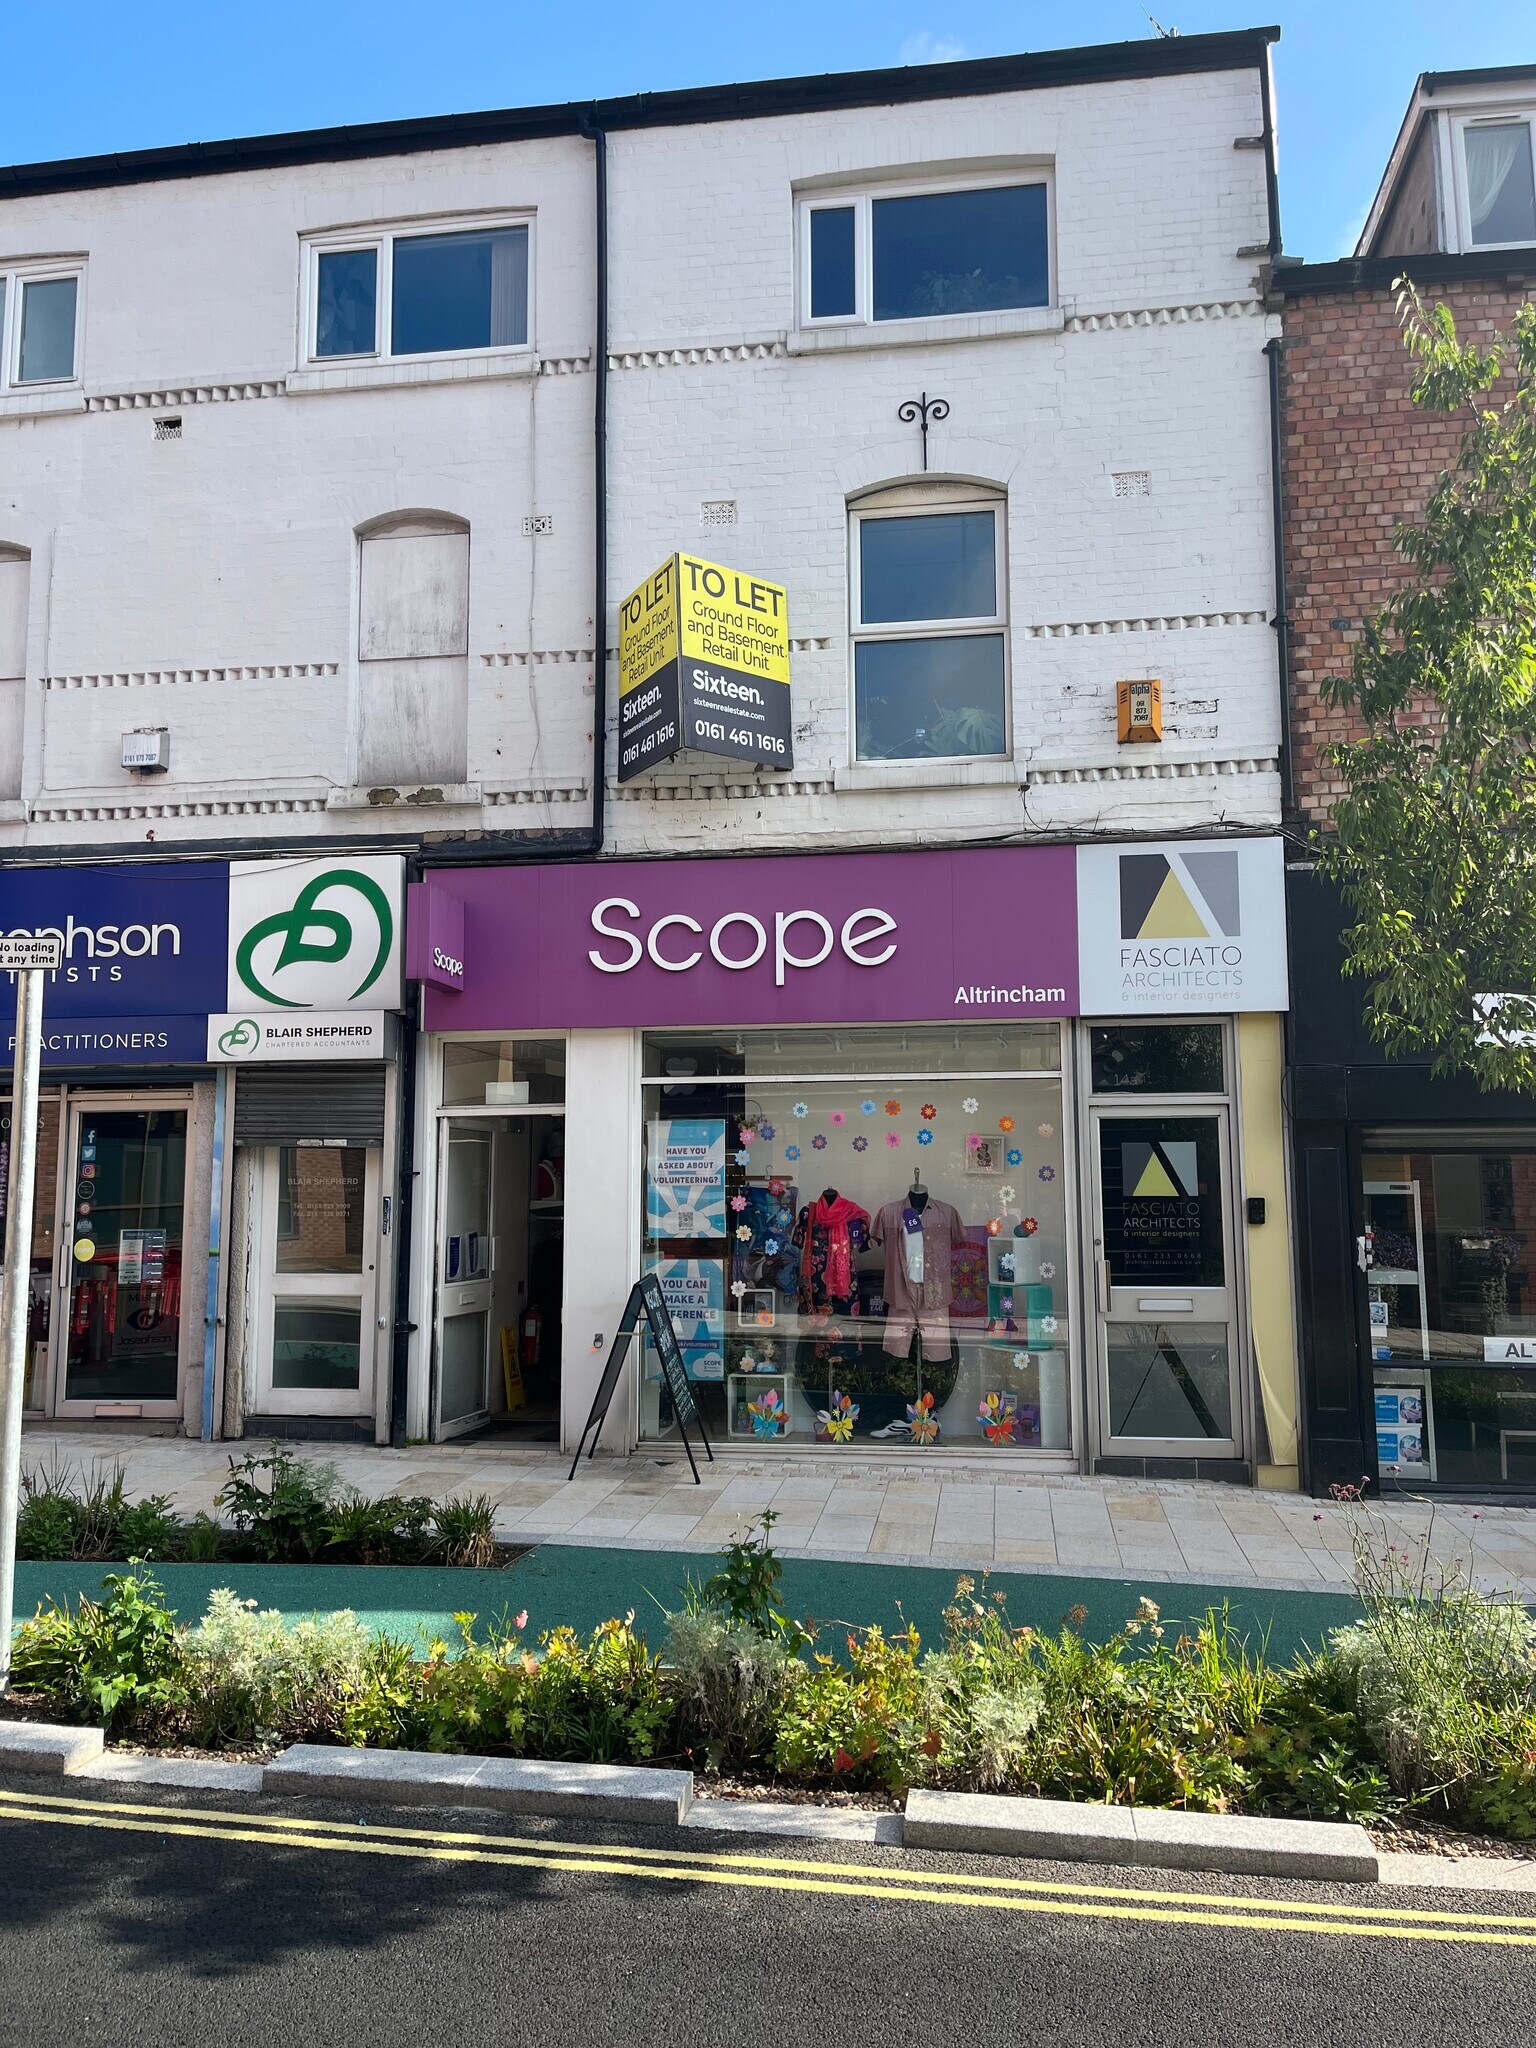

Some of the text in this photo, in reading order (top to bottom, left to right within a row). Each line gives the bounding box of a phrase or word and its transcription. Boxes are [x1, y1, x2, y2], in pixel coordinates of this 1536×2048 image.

[622, 562, 673, 631] TO LET
[684, 560, 783, 617] TO LET
[625, 605, 670, 652] Ground Floor
[693, 600, 778, 639] Ground Floor
[622, 620, 674, 672] and Basement
[688, 619, 784, 658] and Basement
[629, 645, 665, 683] Retail Unit
[702, 639, 769, 671] Retail Unit
[693, 669, 765, 705] Sixteen.
[1131, 684, 1150, 696] alpha
[623, 686, 662, 722] Sixteen.
[694, 698, 765, 721] sixteenrealestate.com
[623, 721, 675, 765] 0161 461 1616
[695, 720, 785, 754] 0161 461 1616
[14, 942, 55, 954] loading
[588, 897, 898, 986] Scope
[7, 956, 27, 965] any
[31, 954, 55, 963] time
[433, 947, 463, 976] Scope
[1121, 946, 1242, 967] FASCIATO
[1122, 970, 1242, 988] ARCHITECTS
[954, 985, 1065, 1004] Altrincham
[1122, 990, 1240, 1002] & interior designers
[266, 1026, 373, 1038] BLAIR SHEPHERD
[666, 1147, 706, 1155] HAVE YOU
[653, 1176, 718, 1184] VOLUNTEERING?
[1122, 1202, 1200, 1216] FASCIATO
[909, 1219, 918, 1227] £6
[1124, 1217, 1200, 1228] ARCHITECTS
[1163, 1230, 1200, 1238] designers
[661, 1280, 707, 1289] YOU CAN
[664, 1295, 705, 1303] MAKE A
